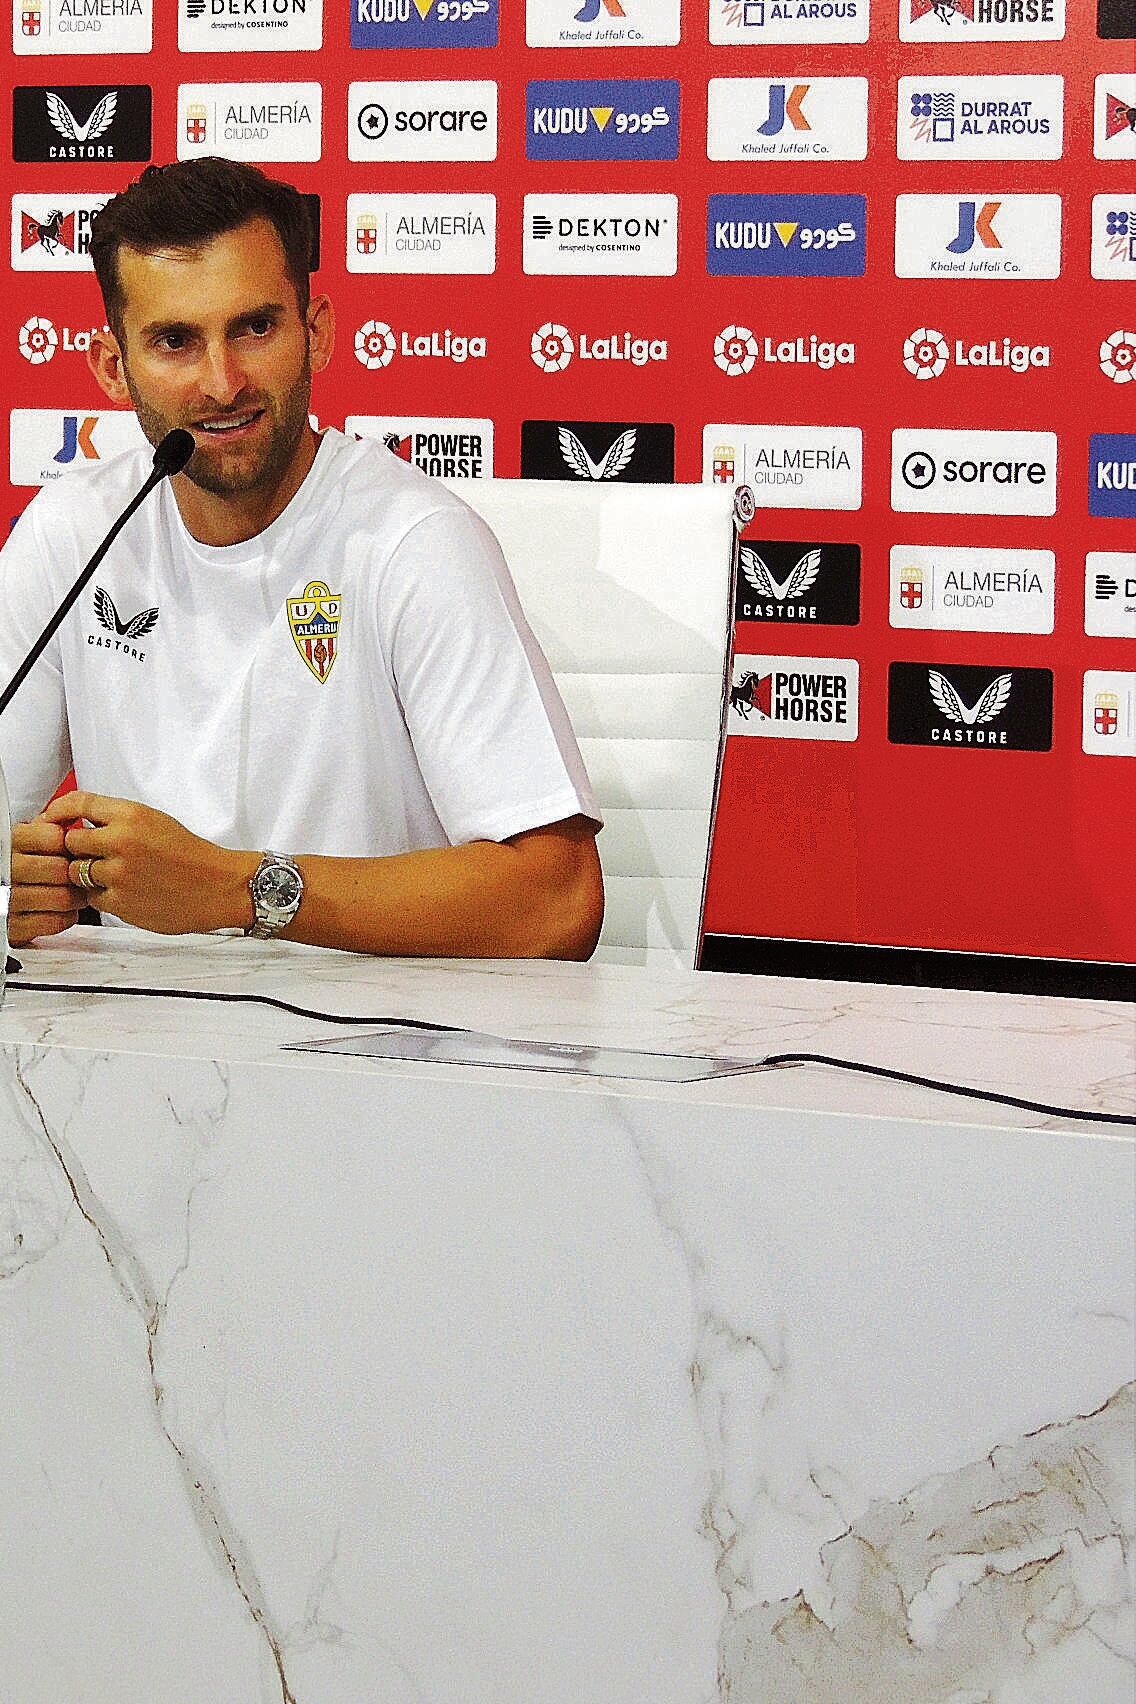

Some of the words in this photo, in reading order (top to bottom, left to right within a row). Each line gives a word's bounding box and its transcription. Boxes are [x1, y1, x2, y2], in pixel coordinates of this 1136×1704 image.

[212, 0, 305, 14] DEKTON
[357, 0, 410, 22] KUDU
[771, 4, 792, 18] AL
[797, 3, 856, 18] AROUS
[978, 0, 1053, 23] HORSE
[59, 20, 101, 32] CIUDAD
[560, 31, 592, 40] Khaled
[596, 30, 624, 39] Juffali
[628, 30, 643, 39] Co.
[226, 101, 311, 124] ALMERÍA
[962, 102, 1032, 116] DURRAT
[395, 111, 487, 131] sorare
[534, 107, 587, 133] KUDU
[961, 120, 983, 134] AL
[987, 119, 1049, 134] AROUS
[224, 128, 268, 139] CIUDAD
[50, 146, 113, 157] CASTORE
[742, 144, 776, 153] Khaled
[779, 144, 809, 153] Juffali
[813, 144, 828, 153] Co.
[397, 212, 485, 235] ALMERÍA
[559, 219, 659, 237] DEKTON
[396, 239, 441, 251] CIUDAD
[715, 223, 771, 248] KUDU
[931, 262, 965, 271] Khaled
[970, 262, 1000, 271] Juffali
[1004, 262, 1020, 271] Co.
[402, 329, 487, 362] LaLiga
[580, 332, 667, 366] LaLiga
[765, 335, 855, 369] LaLiga
[956, 338, 1049, 372] LaLiga
[416, 434, 482, 457] POWER
[756, 446, 850, 470] ALMERÍA
[755, 472, 803, 484] CIUDAD
[943, 461, 1046, 484] sorare
[945, 569, 1042, 593] ALMERÍA
[744, 604, 816, 618] CASTORE
[944, 594, 993, 608] CIUDAD
[88, 636, 146, 663] CASTORE
[776, 673, 846, 698] POWER
[775, 698, 846, 723] HORSE
[932, 729, 1007, 744] CASTORE
